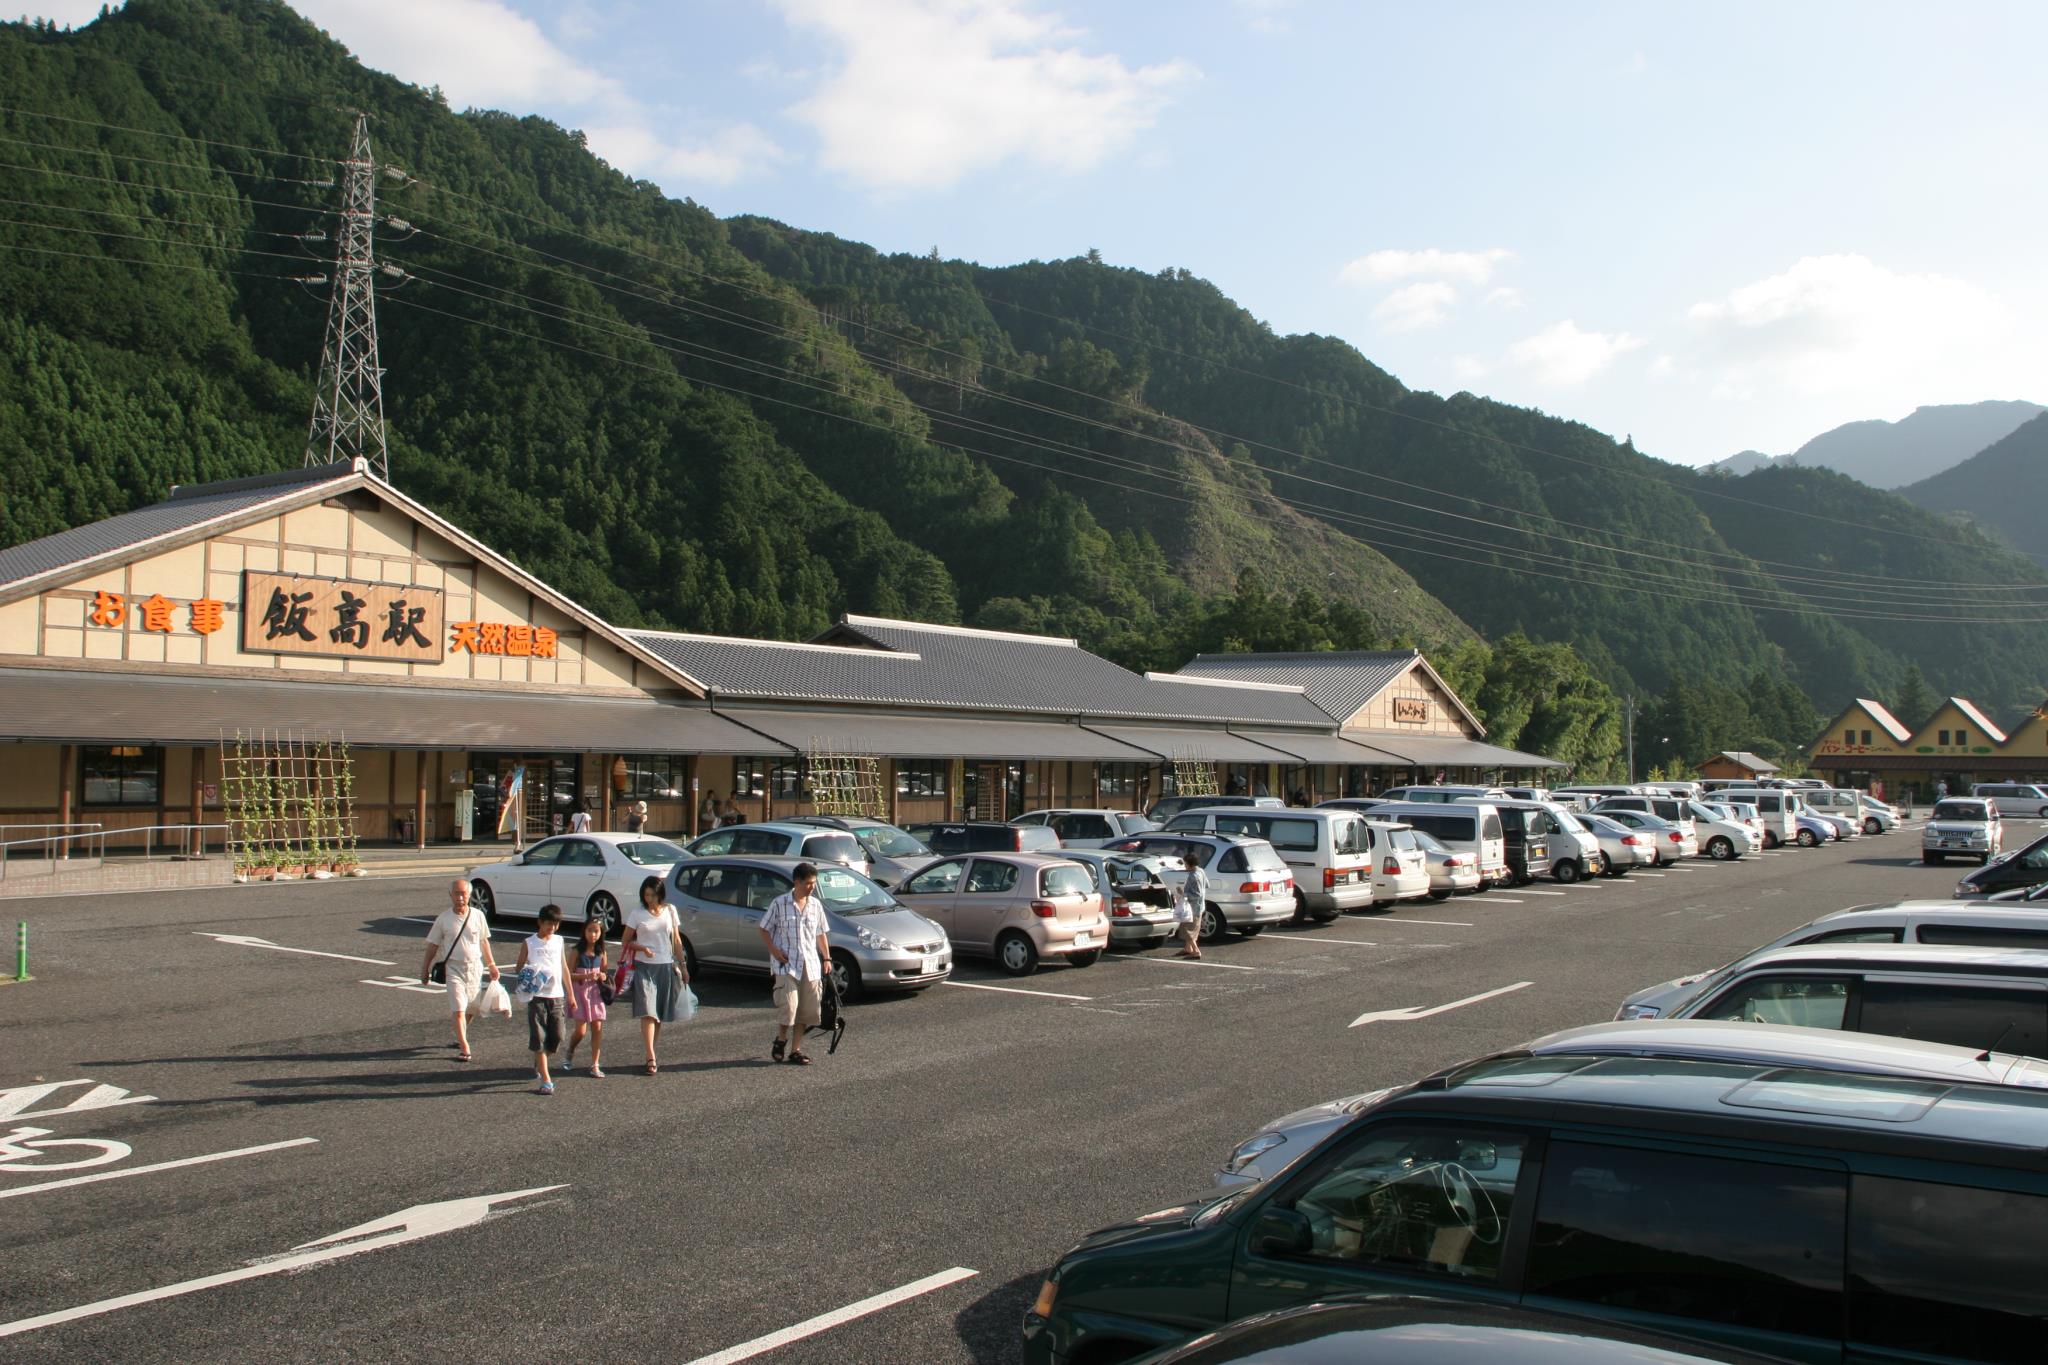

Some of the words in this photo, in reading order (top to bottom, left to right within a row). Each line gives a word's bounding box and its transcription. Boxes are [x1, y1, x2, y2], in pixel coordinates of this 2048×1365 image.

[90, 590, 225, 635] お食事
[260, 585, 433, 650] 飯高駅
[449, 620, 558, 658] 天然温泉
